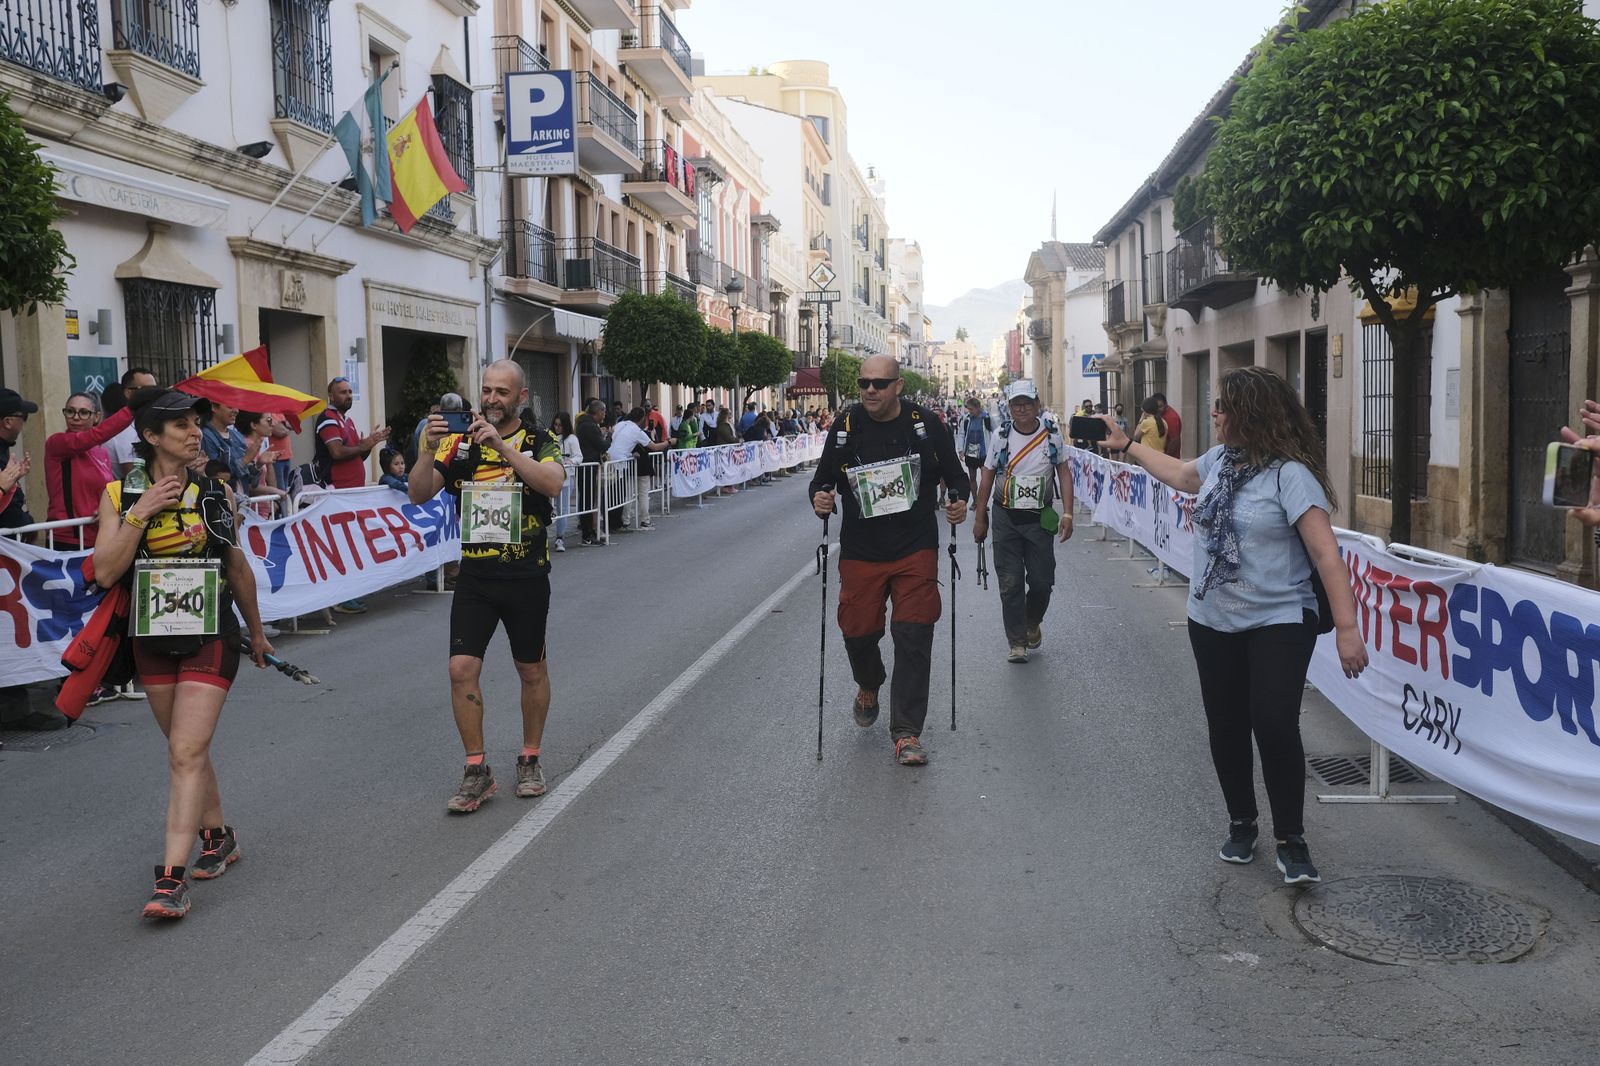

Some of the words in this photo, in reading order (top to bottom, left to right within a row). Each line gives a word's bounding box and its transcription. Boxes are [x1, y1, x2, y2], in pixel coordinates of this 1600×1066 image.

[510, 159, 572, 168] MAESTRANZA
[387, 301, 414, 318] HOTEL
[416, 304, 463, 326] MAESTRANZA
[472, 509, 511, 526] 1309
[151, 592, 204, 613] 1540
[1402, 683, 1462, 755] CARY
